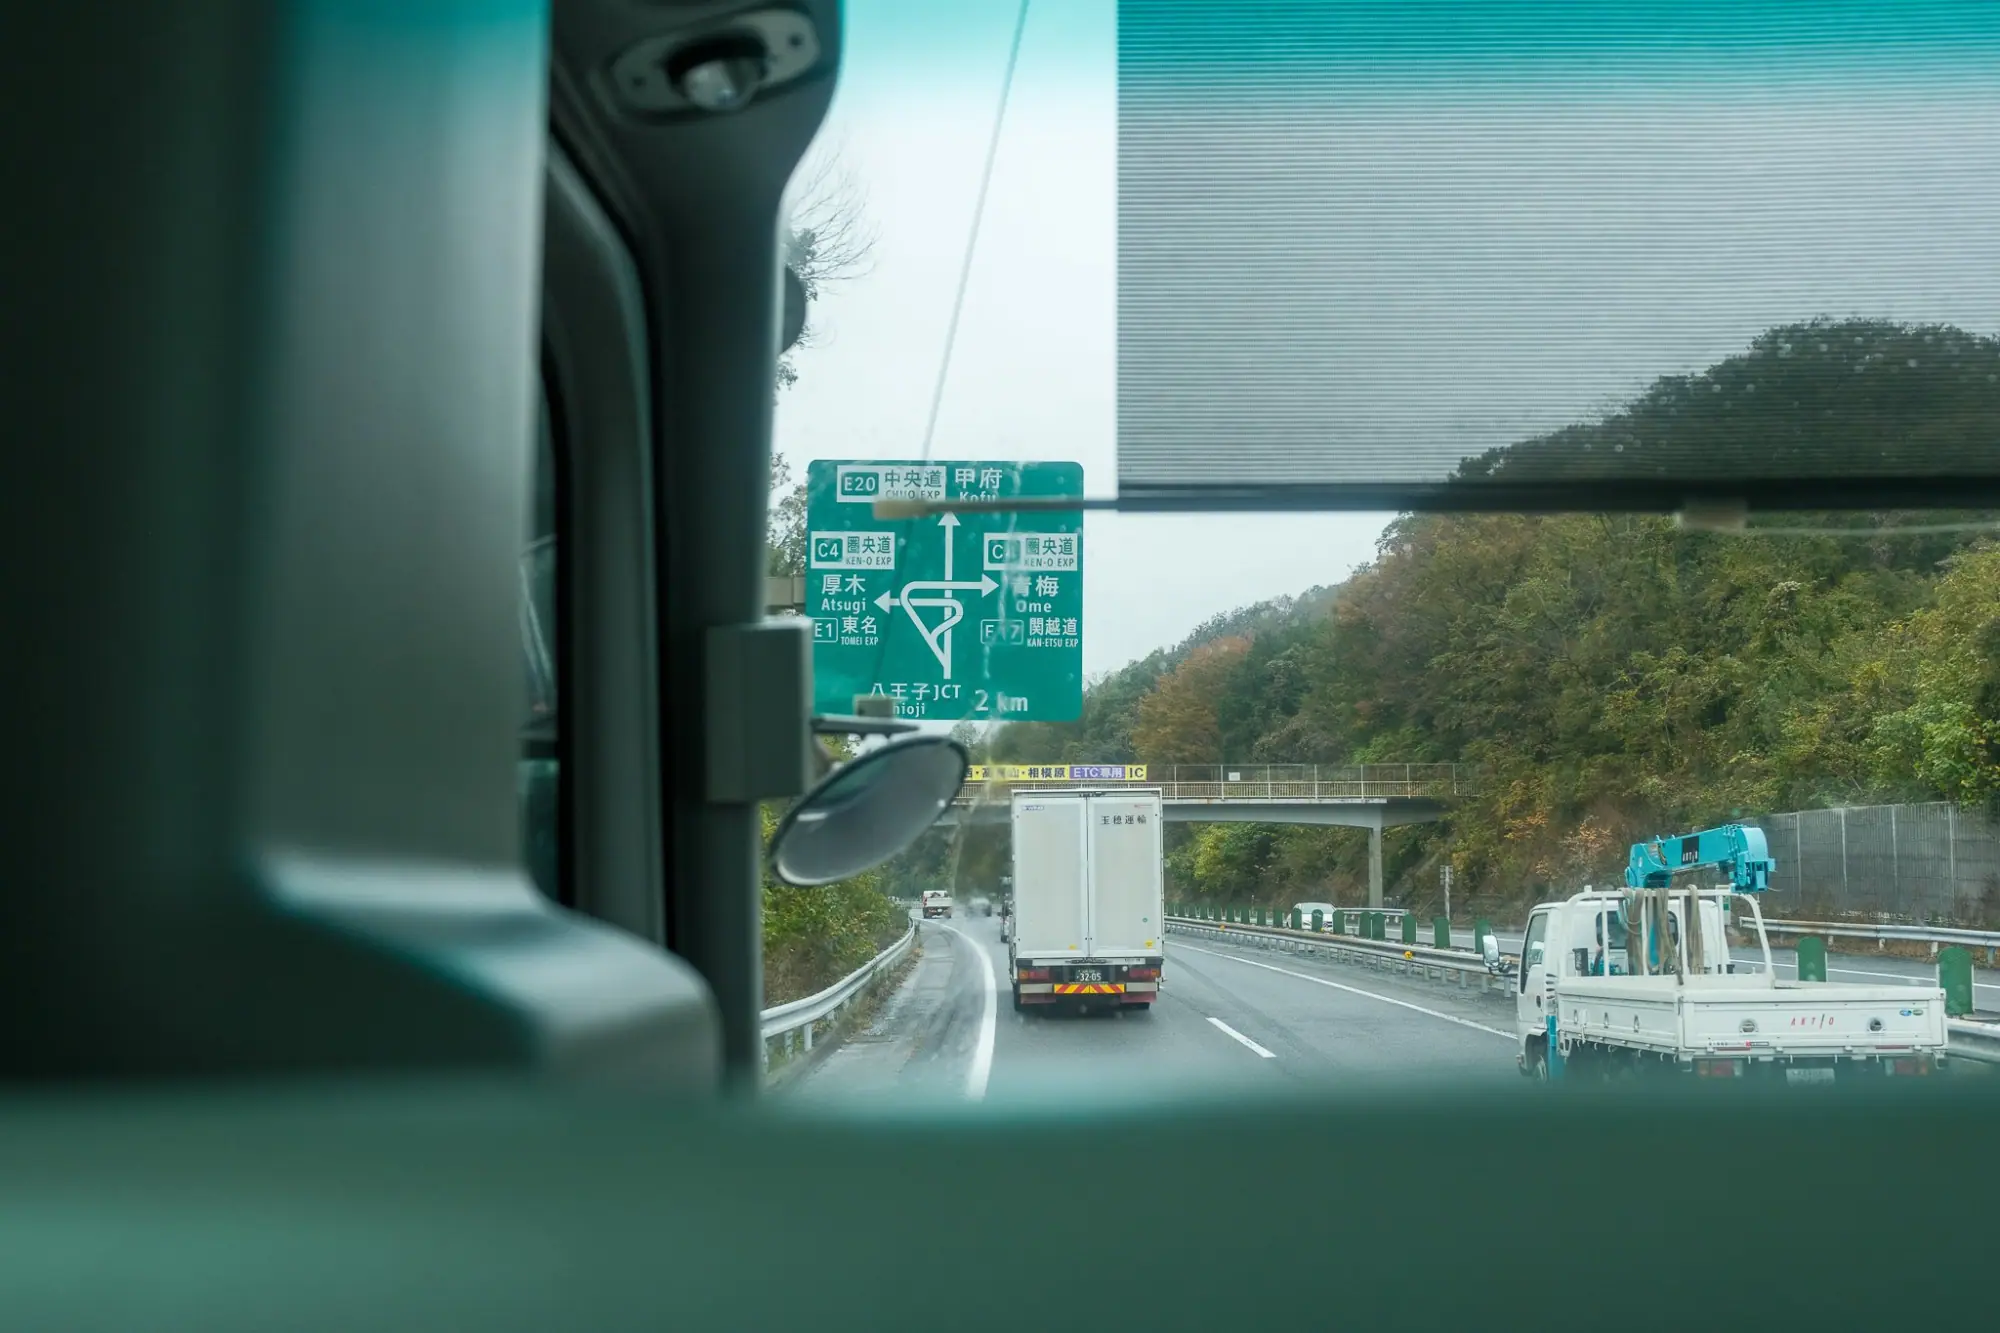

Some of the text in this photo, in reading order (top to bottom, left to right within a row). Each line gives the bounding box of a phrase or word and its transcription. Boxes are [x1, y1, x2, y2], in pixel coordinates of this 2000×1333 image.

[844, 476, 876, 491] E20
[885, 469, 942, 488] 中央道
[955, 467, 1003, 489] 甲府
[818, 543, 839, 558] C4
[847, 536, 892, 554] 圏央道
[845, 556, 892, 565] KEN-O EXP
[1024, 558, 1075, 567] KEN-O EXP
[821, 574, 866, 596] 厚木
[1012, 575, 1060, 597] 青梅
[821, 598, 866, 614] Atsugi
[1015, 600, 1052, 613] Ome
[814, 623, 832, 638] E1
[841, 615, 877, 635] 東名
[985, 624, 1020, 640] E7
[1029, 617, 1078, 636] 関越道
[841, 636, 879, 646] TOMEI EXP
[1026, 638, 1079, 648] KAN-ETSU EXP
[975, 689, 1029, 713] 2 km
[1129, 767, 1144, 778] IC
